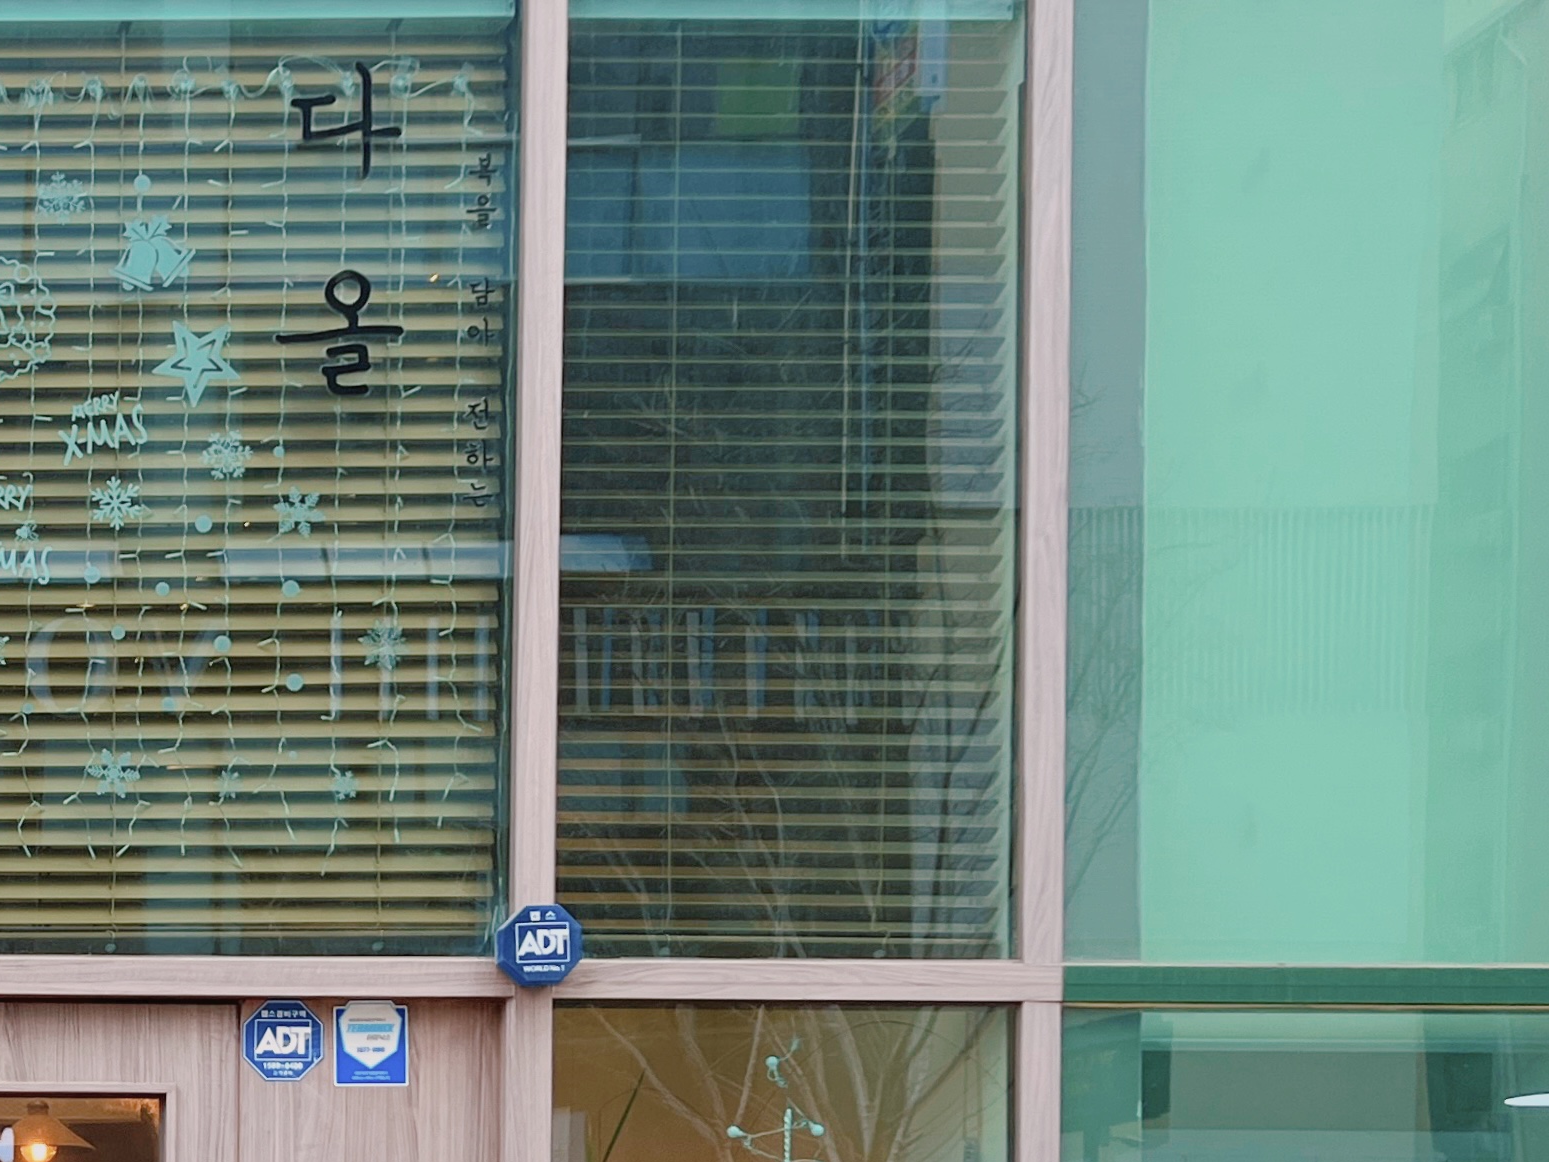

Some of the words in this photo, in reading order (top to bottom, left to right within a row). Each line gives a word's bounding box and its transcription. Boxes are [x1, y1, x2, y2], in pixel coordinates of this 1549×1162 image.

[466, 278, 495, 347] 담아
[71, 391, 120, 421] MERRY
[58, 404, 149, 467] X-MAS
[463, 397, 496, 507] 전하는
[517, 929, 569, 956] ADT
[255, 1026, 311, 1054] ADT
